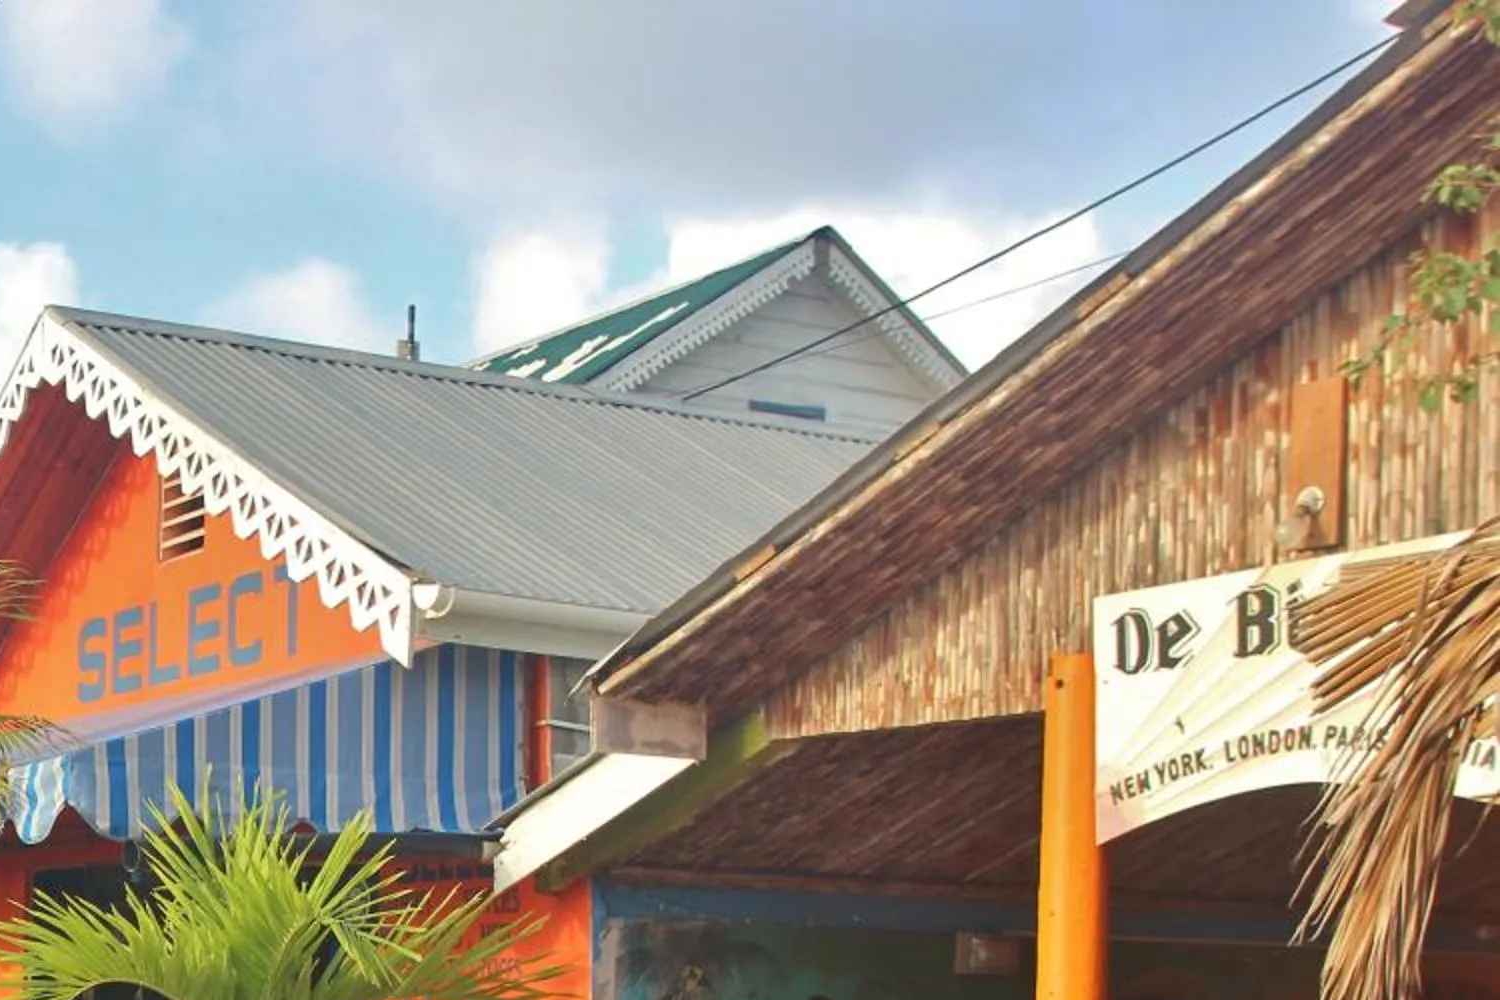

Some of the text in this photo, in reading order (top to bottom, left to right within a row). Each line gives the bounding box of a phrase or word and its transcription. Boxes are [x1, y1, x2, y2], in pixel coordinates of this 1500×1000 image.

[77, 565, 297, 703] SELECT
[1111, 607, 1201, 676] De
[1109, 771, 1151, 806] NEW
